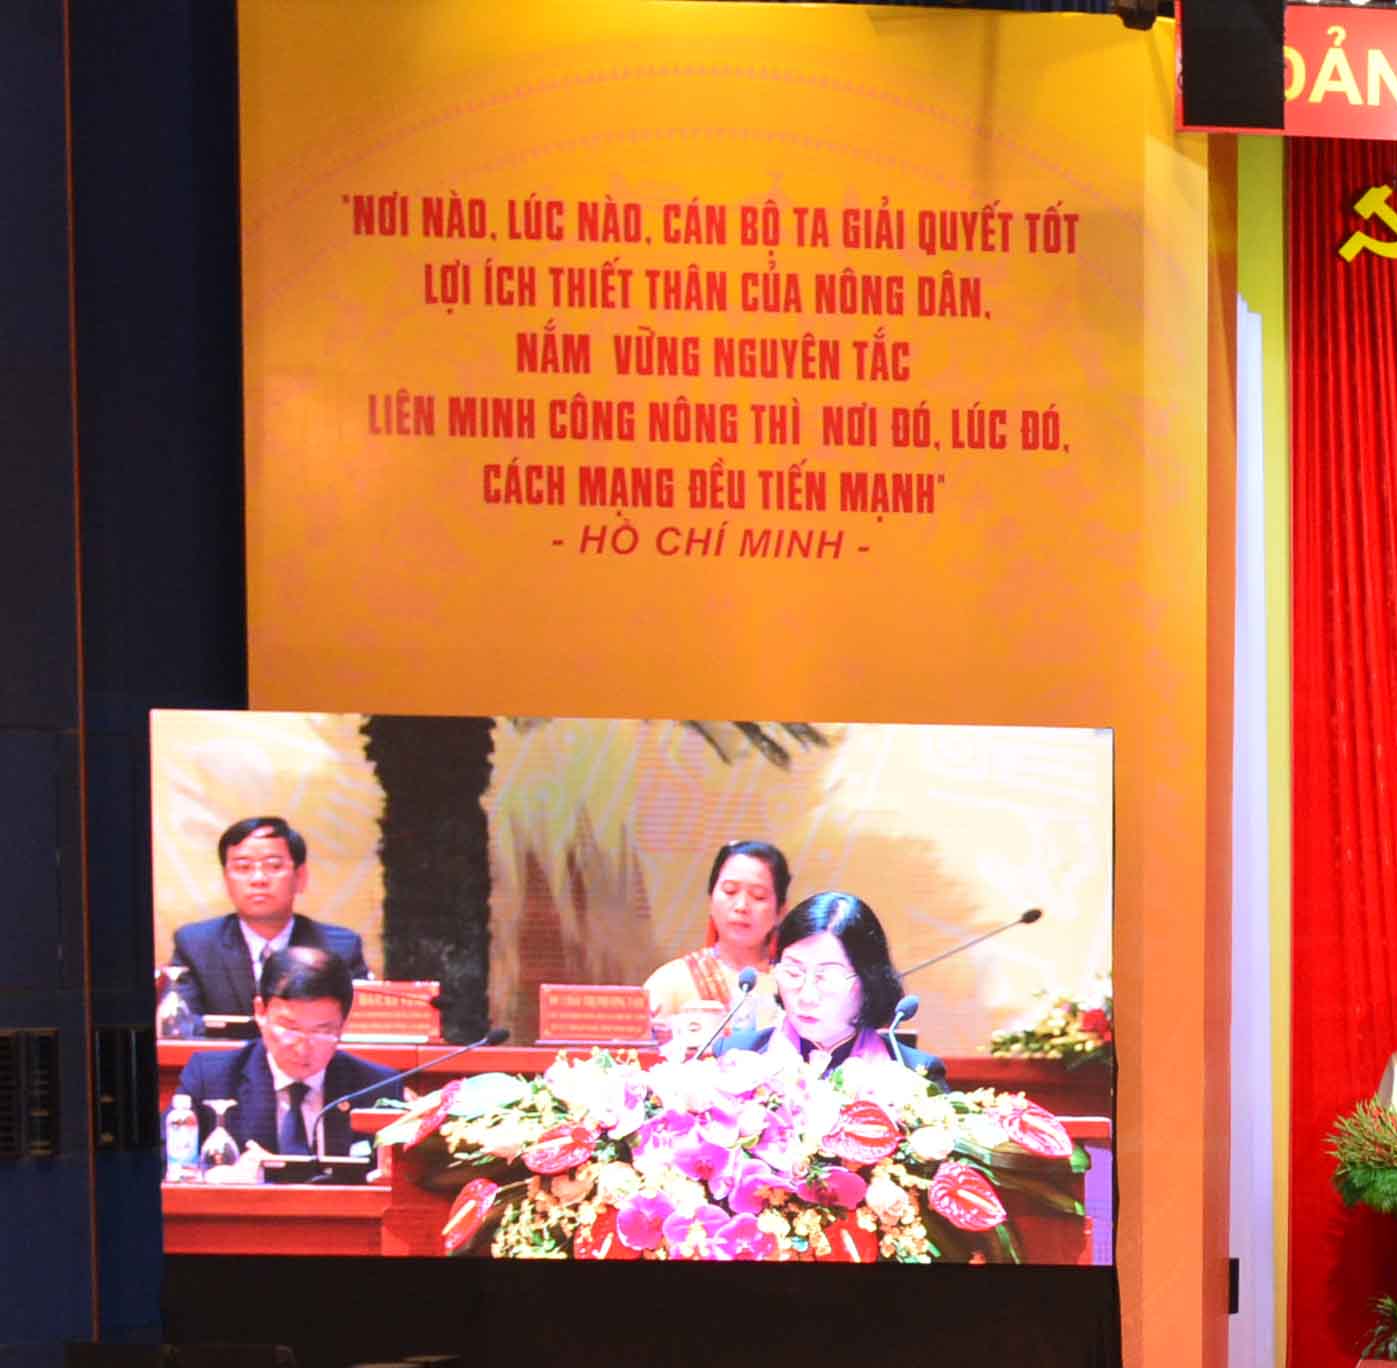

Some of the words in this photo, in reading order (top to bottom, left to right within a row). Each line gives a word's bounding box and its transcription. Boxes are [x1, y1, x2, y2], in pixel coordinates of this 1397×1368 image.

[422, 189, 497, 241] NÀO,
[508, 192, 563, 240] LÚC
[578, 194, 651, 246] NÀO,
[663, 196, 726, 245] CÁN
[740, 199, 780, 256] BỘ
[793, 208, 829, 247] TA
[842, 196, 904, 250] GIẢI
[918, 200, 1013, 255] QUYẾT
[1024, 200, 1079, 254] TỐT
[424, 259, 471, 315] LỢI
[484, 258, 536, 306] ÍCH
[550, 257, 632, 308] THIẾT
[645, 263, 727, 311] THÂN
[741, 258, 802, 313] CỦA
[815, 266, 904, 316] NÔNG
[516, 318, 590, 375] NẮM
[613, 325, 700, 377] VỮNG
[714, 332, 840, 380] NGUYÊN
[853, 326, 910, 382] TẮC
[368, 389, 435, 436] LIÊN
[448, 396, 536, 439] MINH
[550, 392, 635, 441] CÔNG
[649, 395, 738, 443] NÔNG
[751, 397, 800, 445] THÌ
[823, 401, 877, 447] NƠI
[952, 401, 1007, 449] LÚC
[483, 457, 565, 505] CÁCH
[579, 466, 675, 517] MẠNG
[688, 458, 745, 511] ĐỀU
[758, 458, 827, 512] TIẾN
[656, 521, 728, 556] CHÍ
[739, 528, 845, 560] MINH
